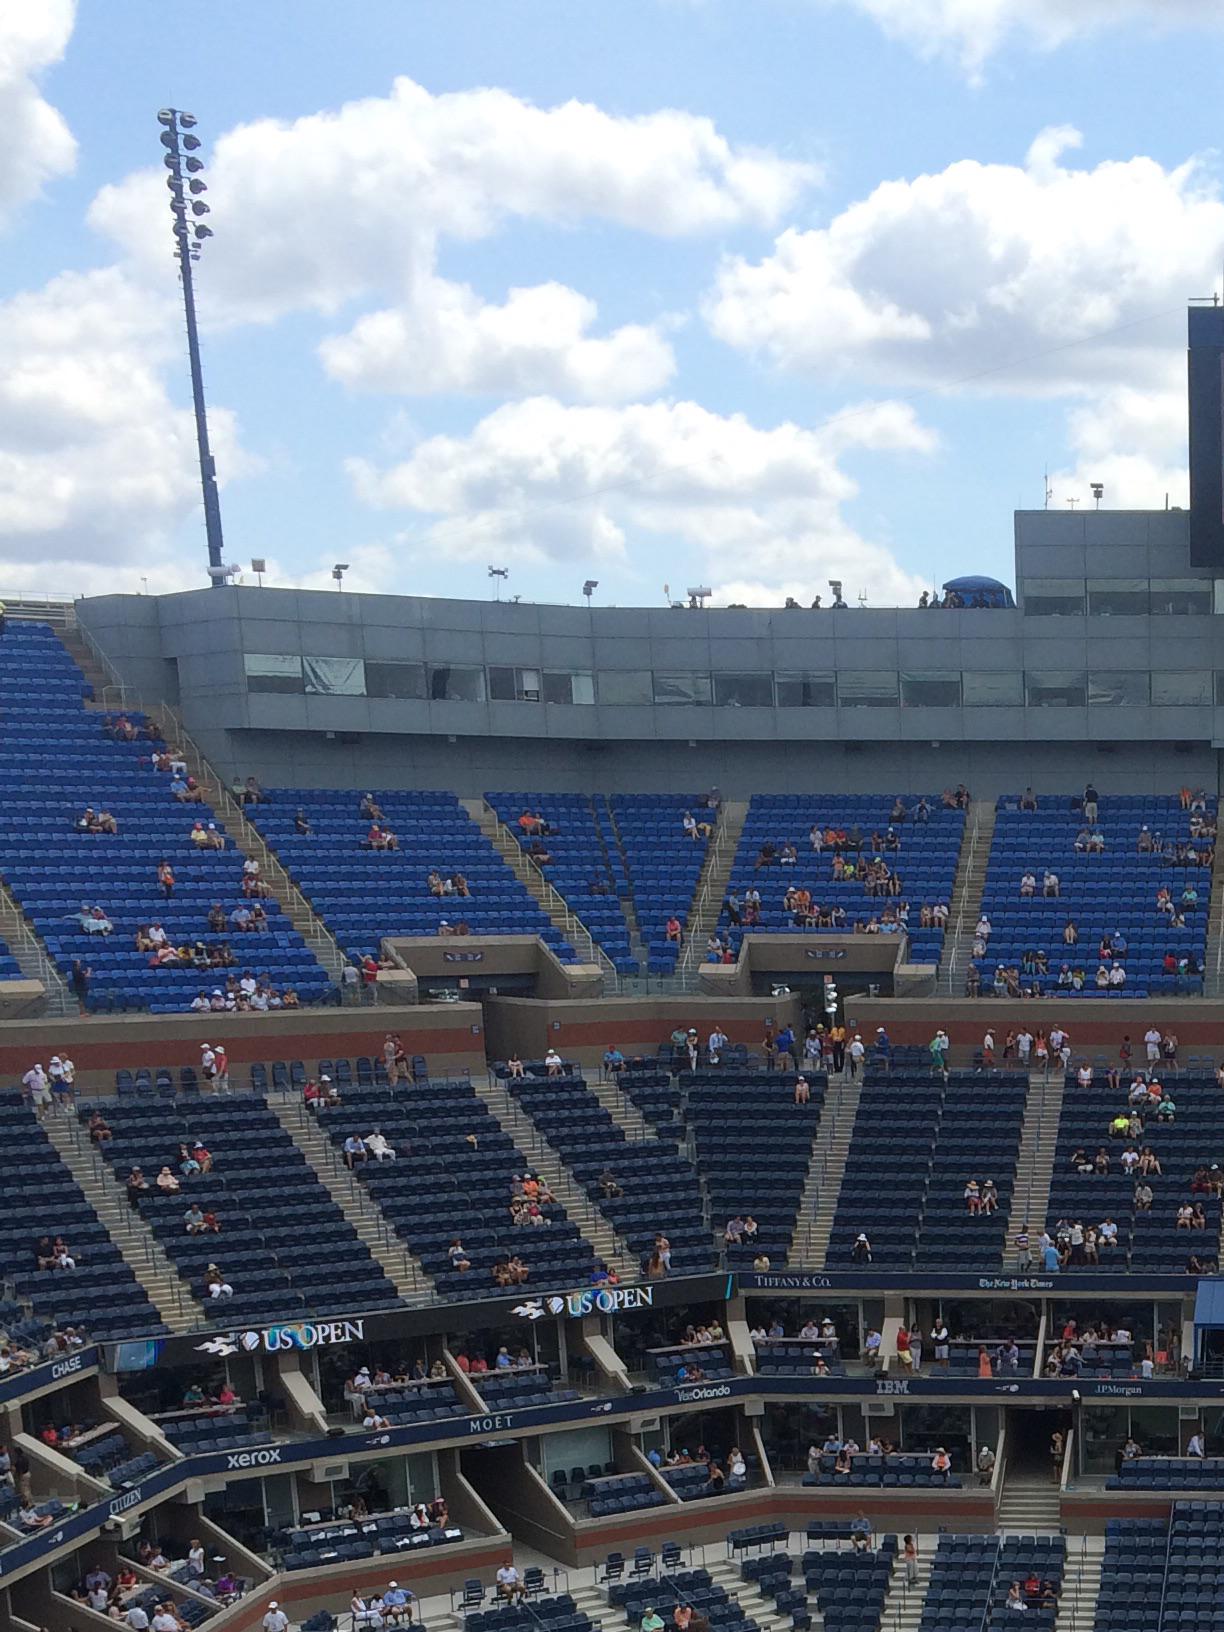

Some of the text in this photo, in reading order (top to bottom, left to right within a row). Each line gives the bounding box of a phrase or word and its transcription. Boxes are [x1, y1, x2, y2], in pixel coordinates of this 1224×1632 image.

[566, 1286, 654, 1315] US OPEN
[262, 1319, 364, 1351] US OPEN
[52, 1356, 82, 1379] CHASE
[876, 1380, 909, 1394] IBM
[227, 1448, 282, 1469] xerox
[109, 1487, 142, 1515] CITIZEN
